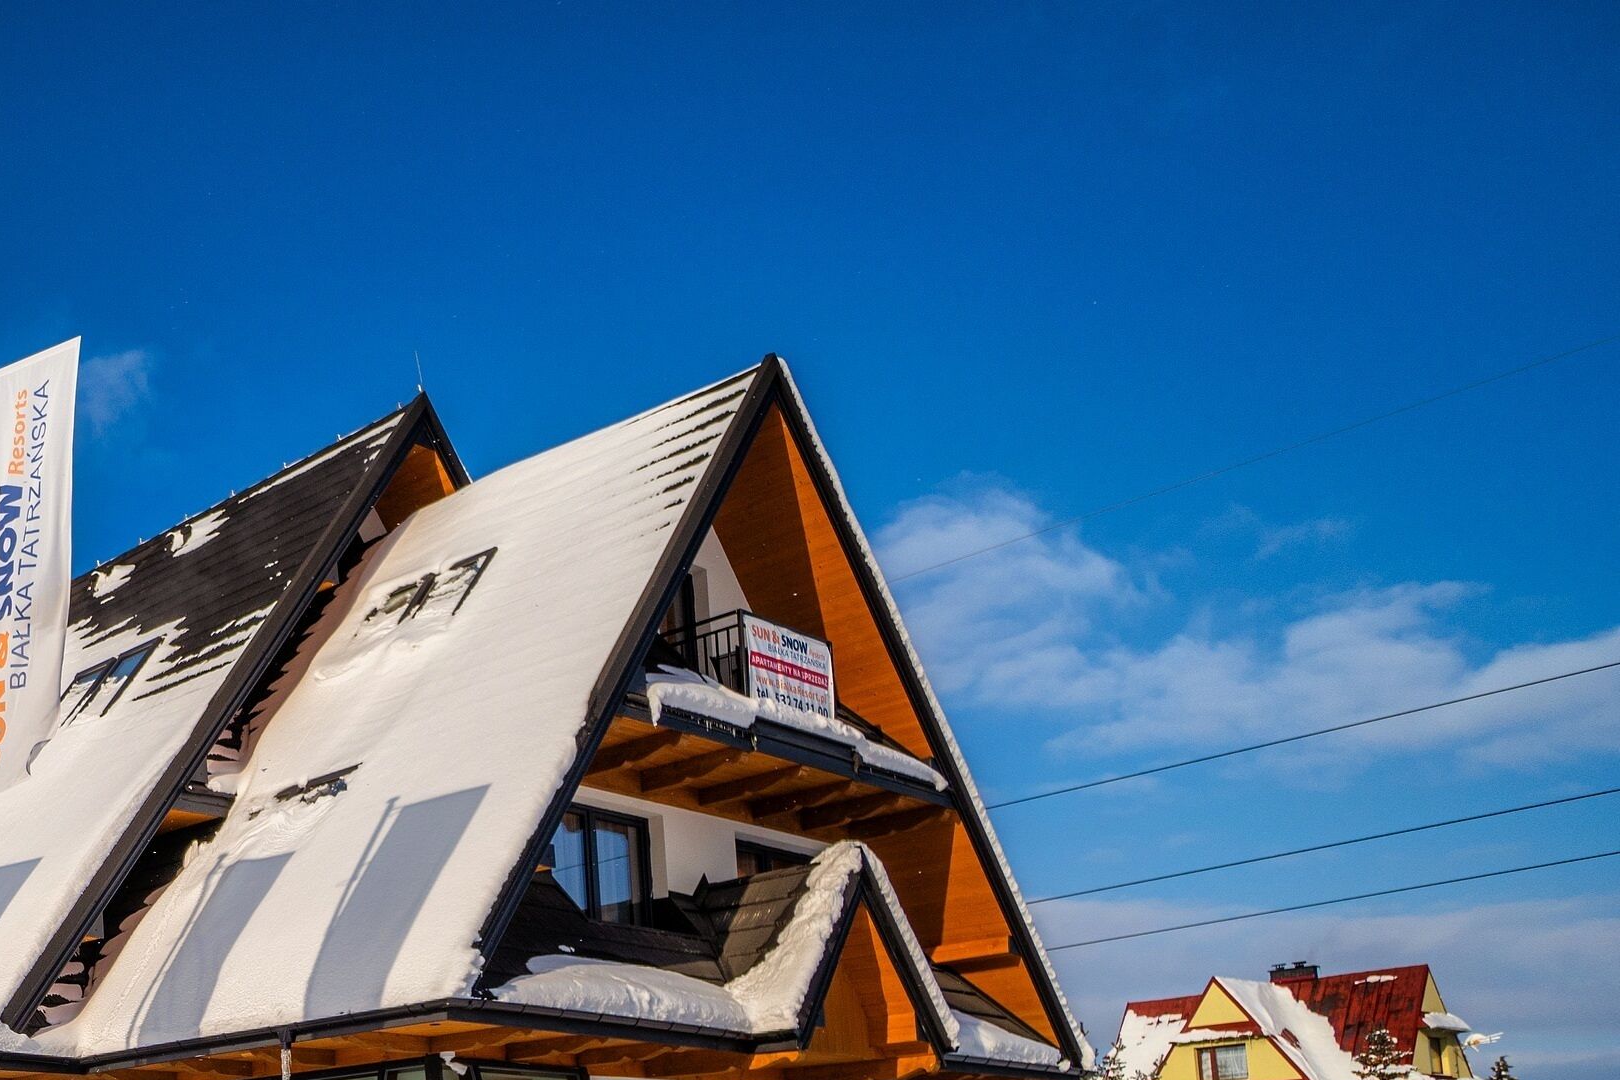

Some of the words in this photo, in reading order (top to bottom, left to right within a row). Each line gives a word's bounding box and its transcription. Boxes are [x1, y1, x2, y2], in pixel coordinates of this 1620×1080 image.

[8, 389, 28, 475] Resorts
[18, 378, 50, 576] TATRZAŃSKA
[10, 581, 36, 690] BIAŁKA
[751, 624, 771, 642] SUN
[771, 630, 780, 645] &
[781, 634, 808, 655] SNOW
